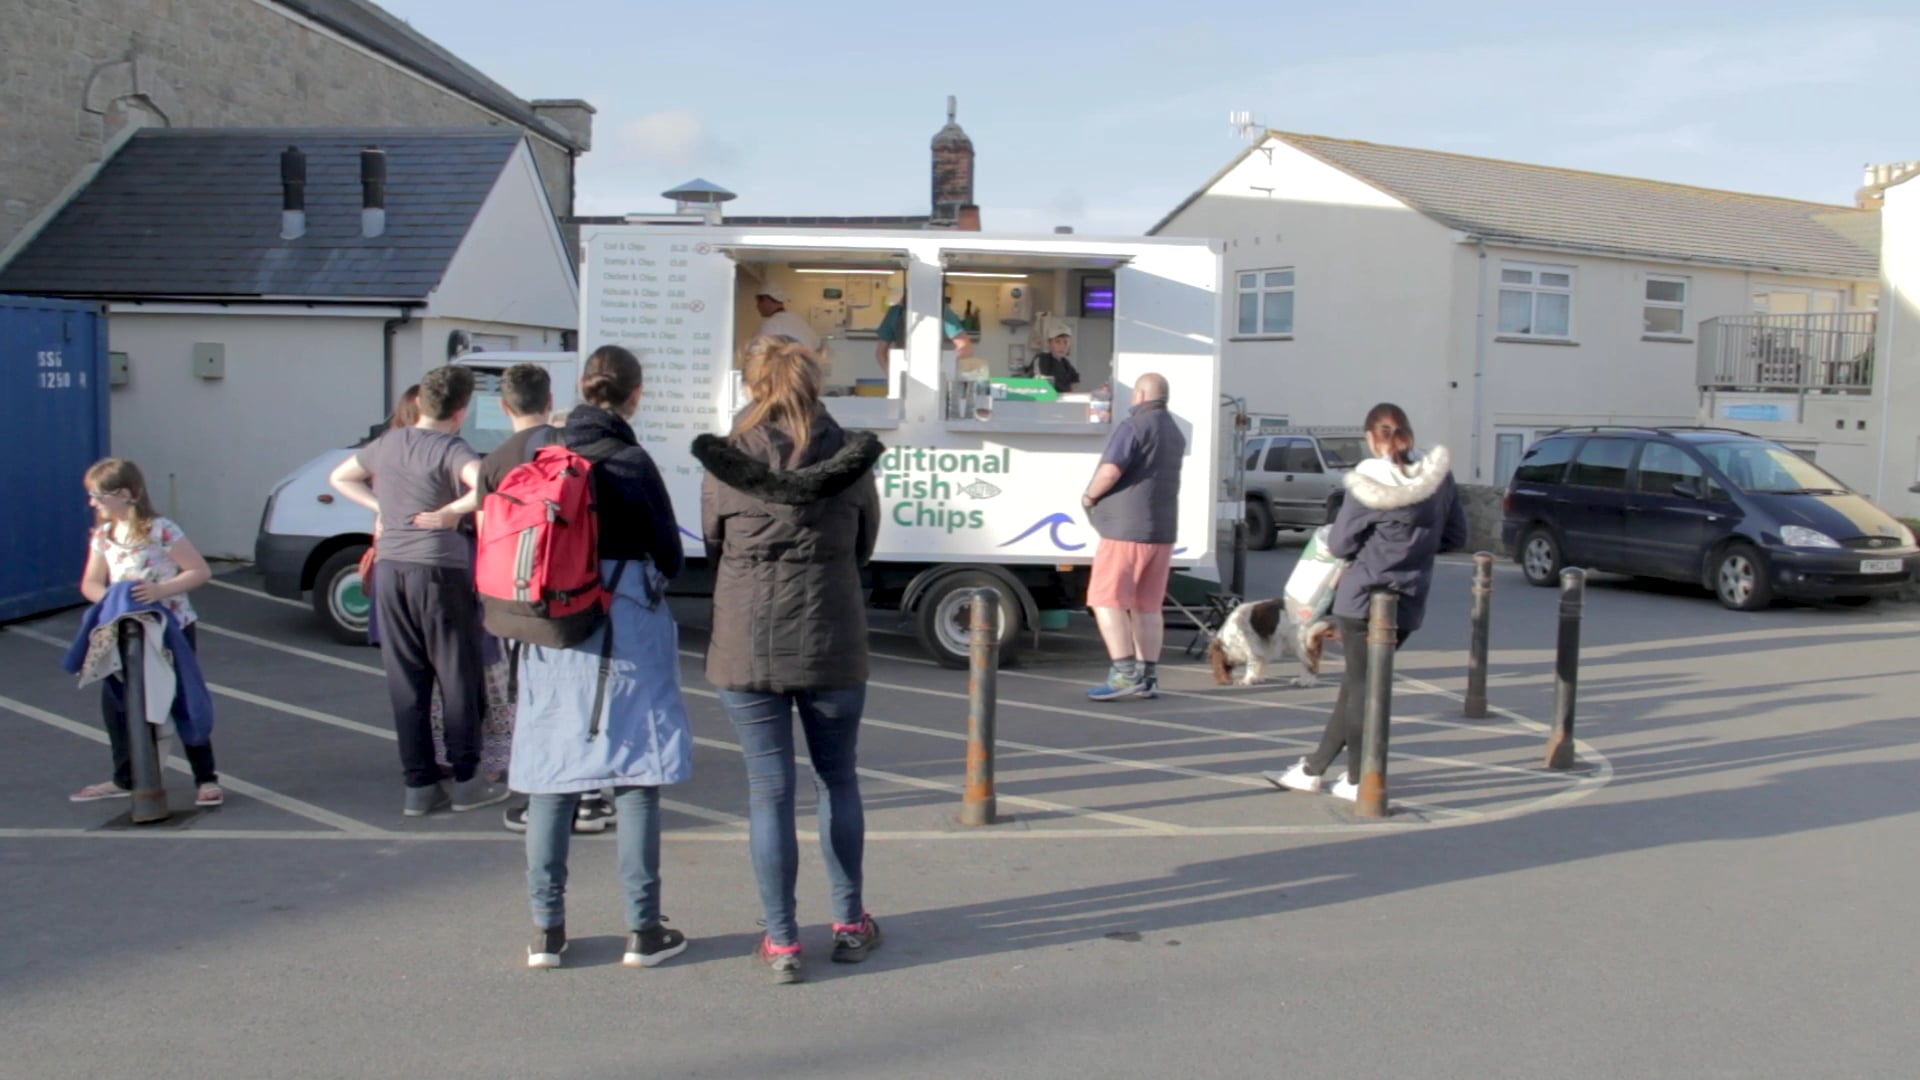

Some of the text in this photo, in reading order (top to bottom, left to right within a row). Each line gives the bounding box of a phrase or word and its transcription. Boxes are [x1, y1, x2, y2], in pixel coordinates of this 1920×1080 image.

[627, 243, 646, 252] Chips
[638, 258, 656, 267] Chips
[639, 272, 658, 282] Chips
[639, 316, 657, 325] Chips
[659, 331, 677, 340] Chips
[874, 445, 1010, 474] ditional
[884, 472, 951, 500] Fish
[892, 501, 984, 534] Chips
